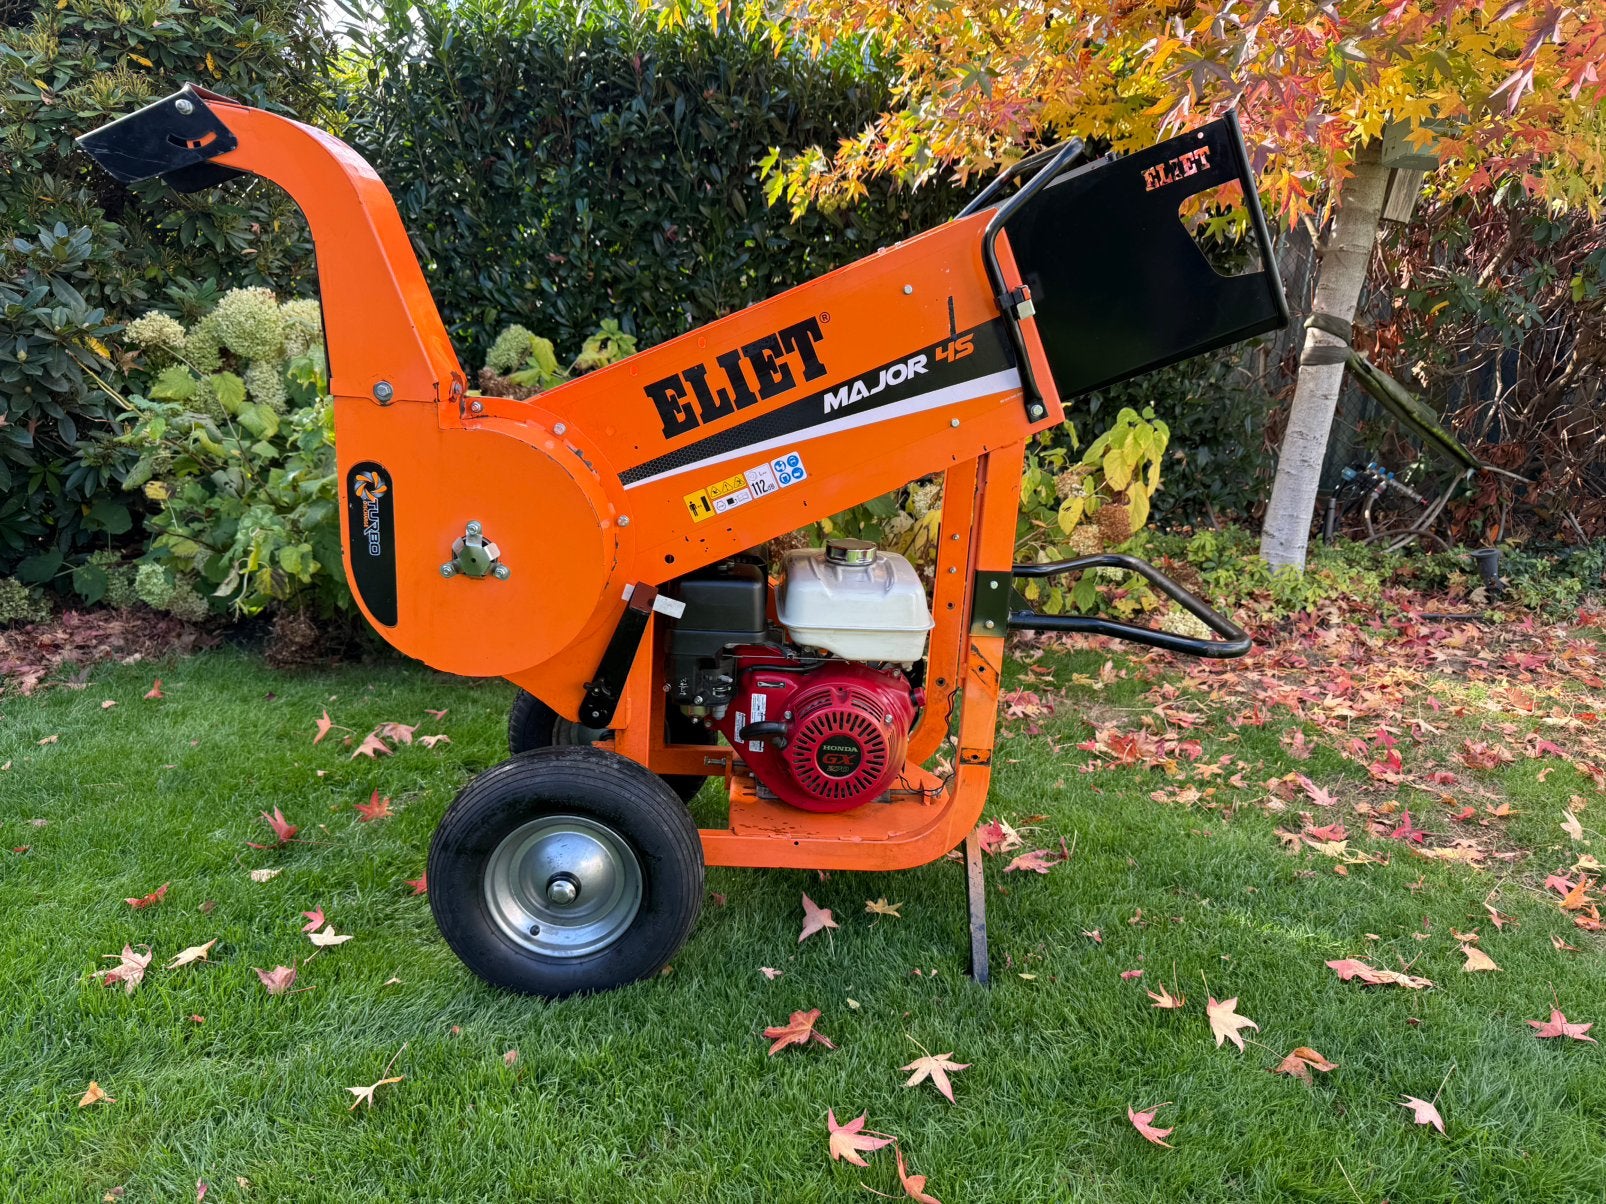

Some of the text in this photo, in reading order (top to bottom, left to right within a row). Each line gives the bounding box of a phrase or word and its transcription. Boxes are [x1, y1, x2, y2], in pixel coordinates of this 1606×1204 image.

[1141, 145, 1211, 192] ELIET
[823, 353, 928, 414] MAJOR
[752, 479, 769, 496] 112
[364, 498, 381, 556] TURBO
[822, 753, 857, 765] GX
